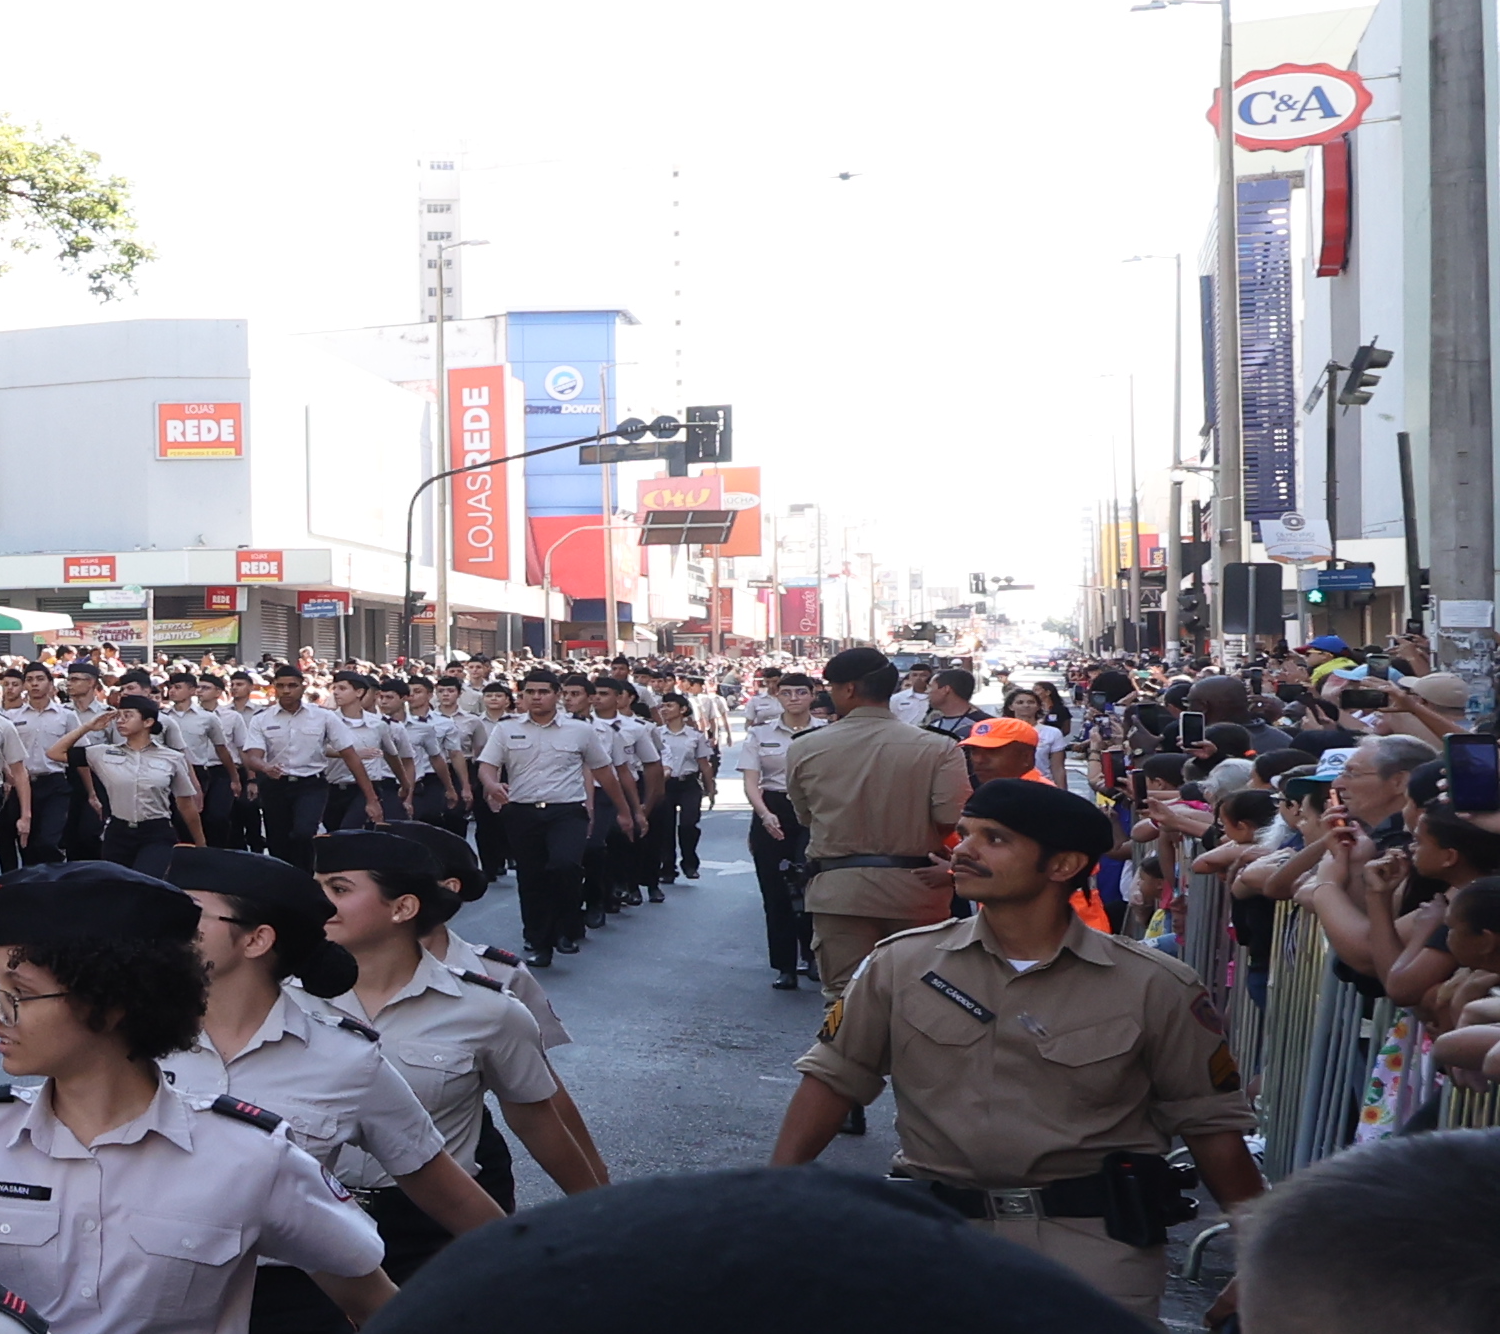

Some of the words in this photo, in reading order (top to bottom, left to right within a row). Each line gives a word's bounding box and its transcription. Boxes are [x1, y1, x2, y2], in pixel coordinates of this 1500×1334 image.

[1238, 86, 1342, 125] C&A
[185, 404, 215, 414] LOJAS
[166, 419, 235, 442] REDE
[466, 475, 494, 562] LOJAS
[69, 565, 111, 576] REDE
[241, 561, 279, 574] REDE
[212, 595, 231, 604] REDE
[153, 621, 193, 631] FERTAS
[931, 978, 947, 989] SGT
[0, 1184, 30, 1195] YASMIN
